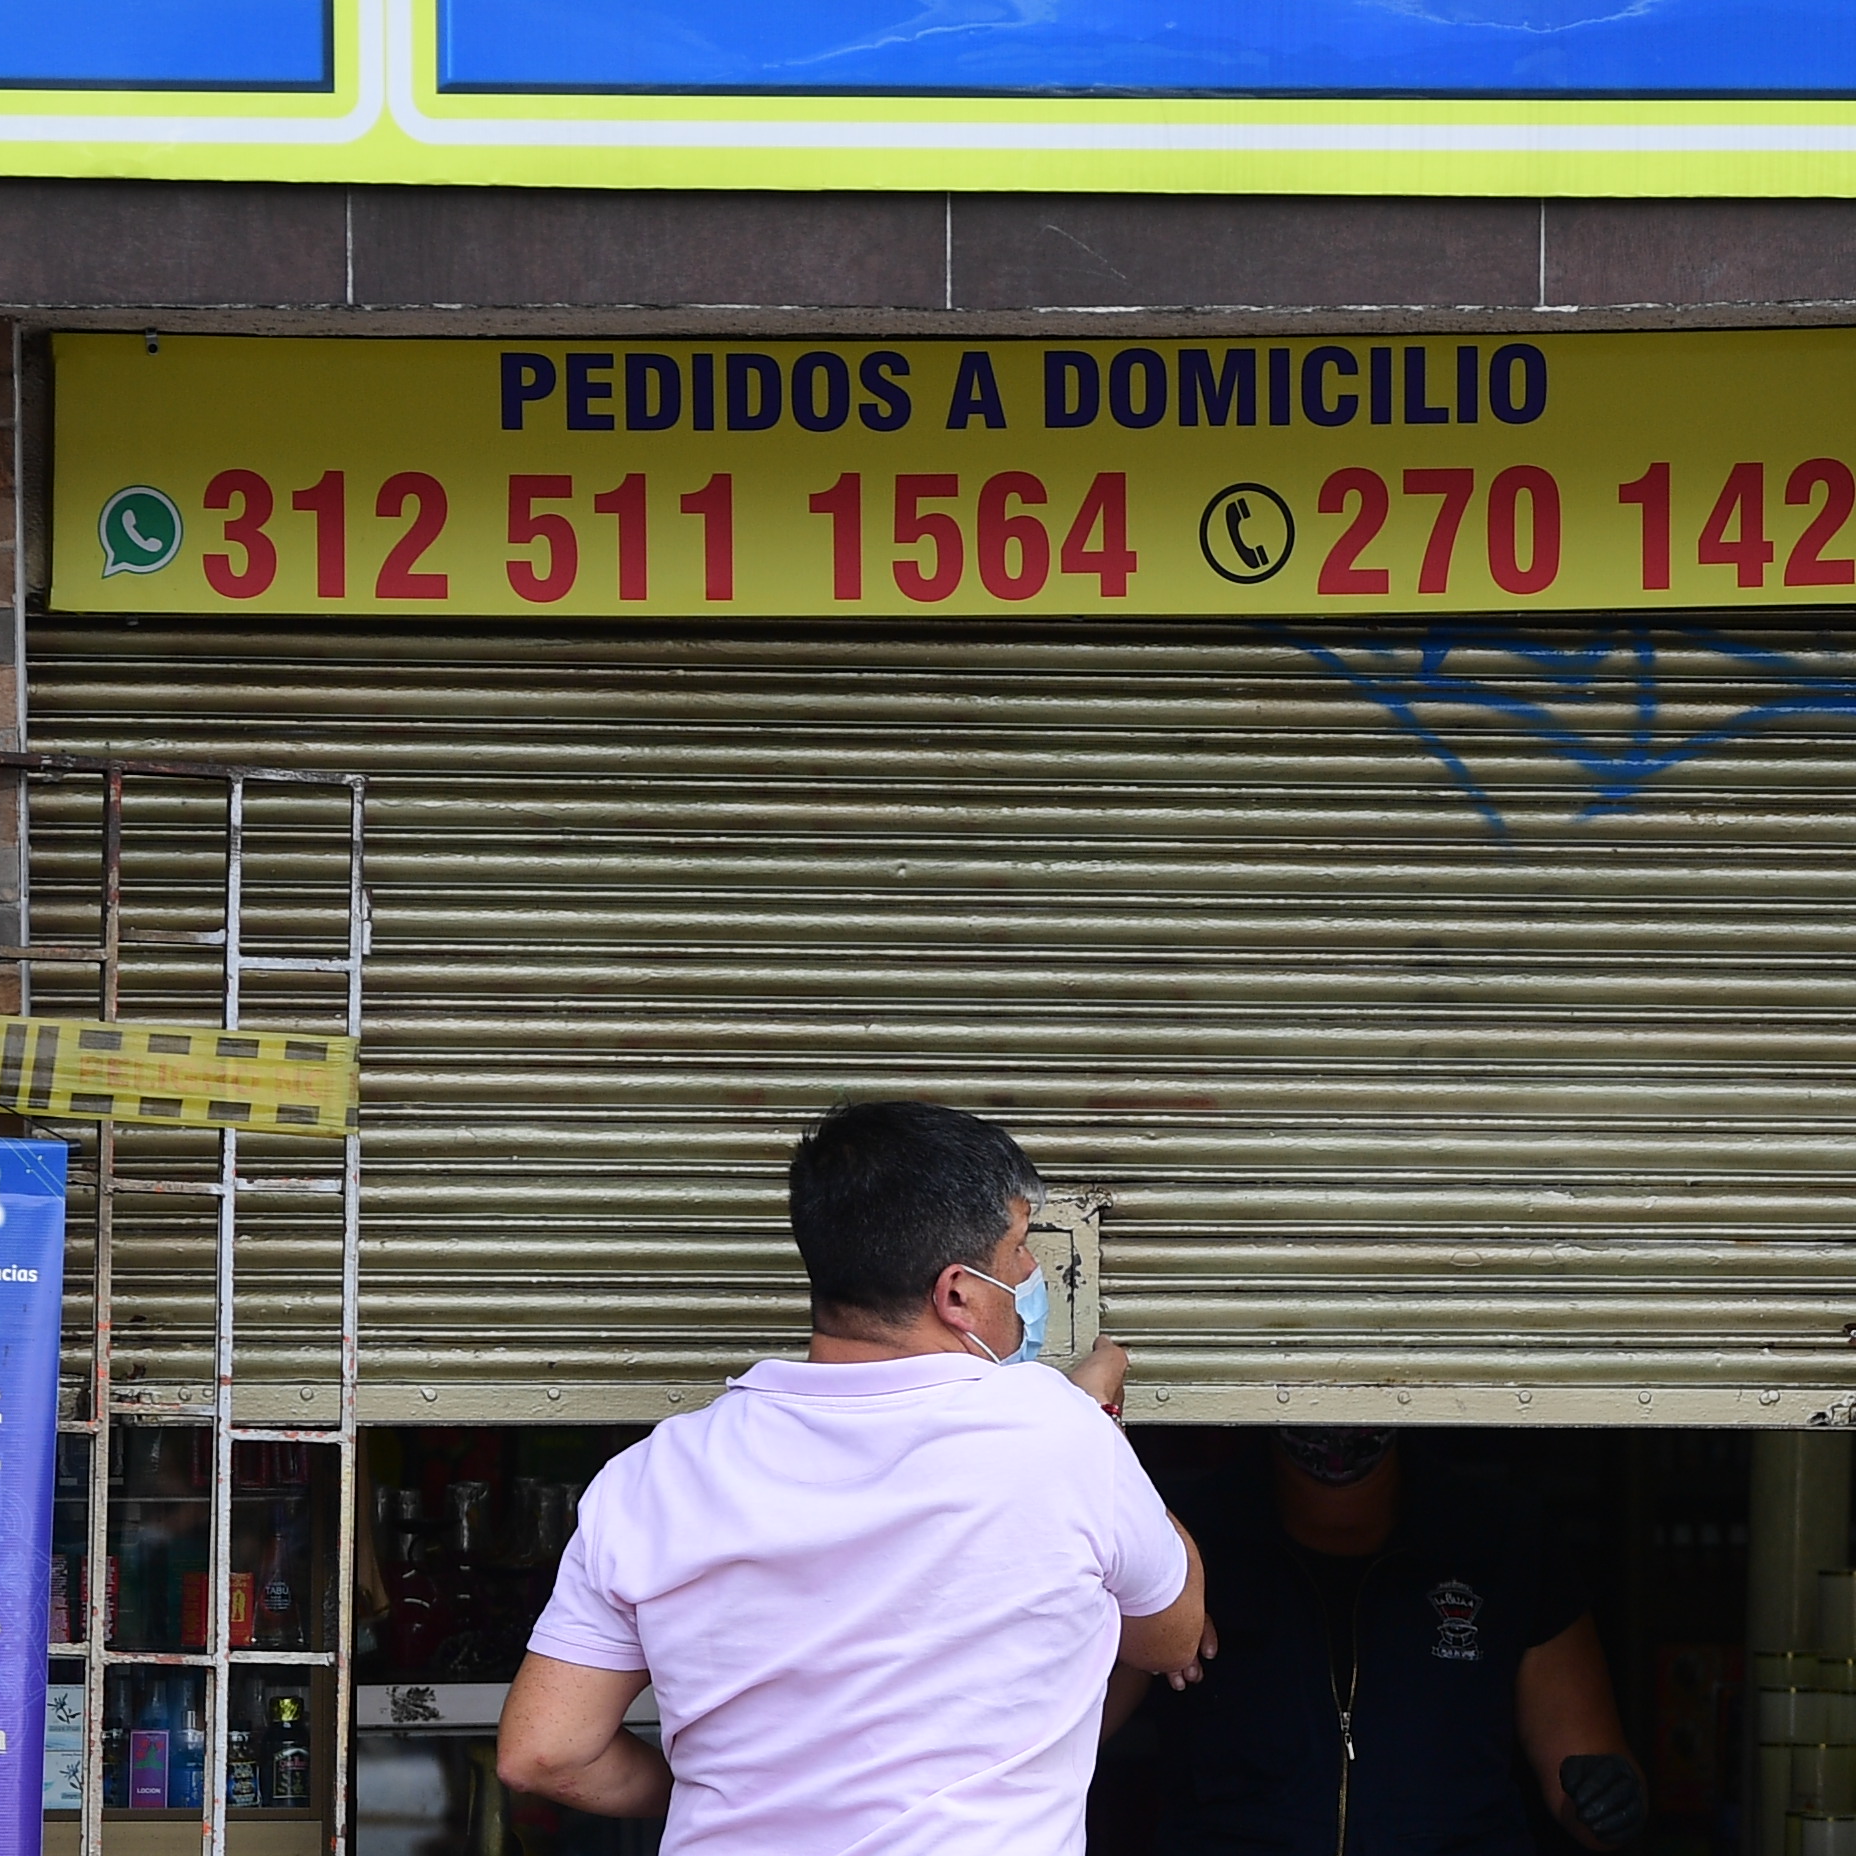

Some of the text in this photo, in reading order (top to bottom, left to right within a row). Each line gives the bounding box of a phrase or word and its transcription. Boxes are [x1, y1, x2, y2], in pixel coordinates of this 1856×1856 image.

[497, 341, 1550, 435] PEDIDOS A DOMICILIO
[202, 464, 1138, 607] 312 511 1564
[1314, 464, 1565, 599] 270
